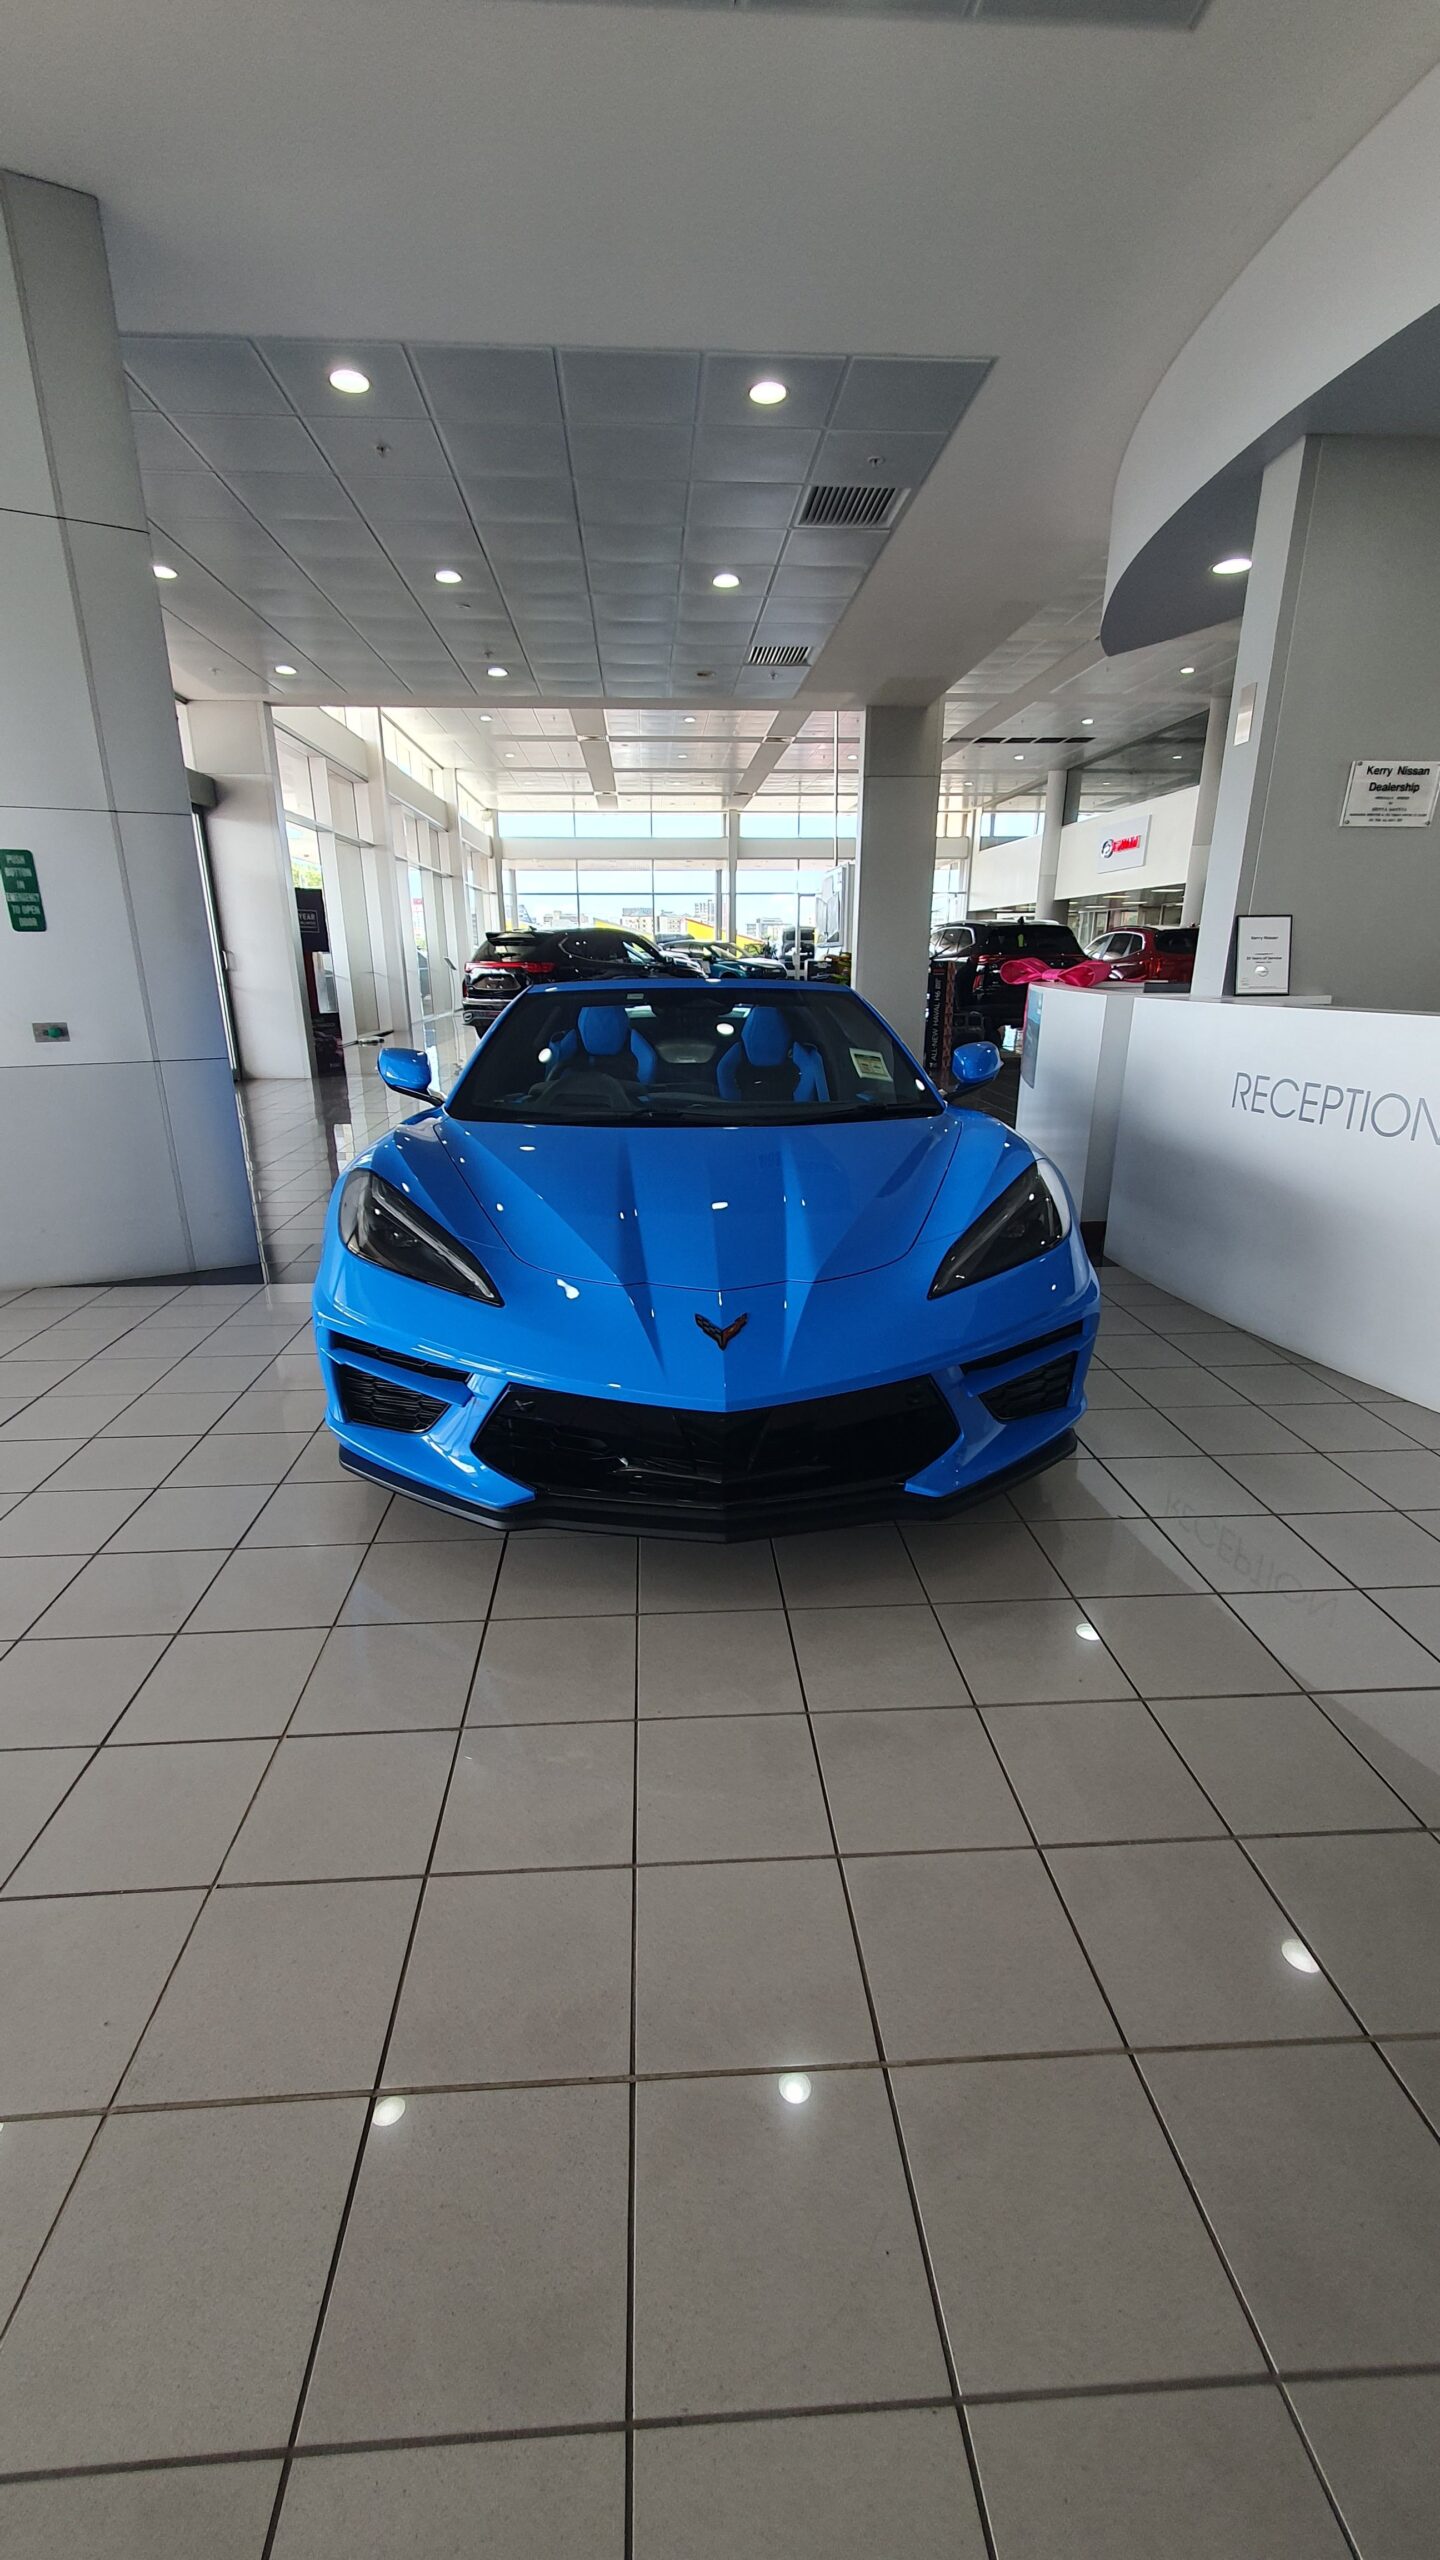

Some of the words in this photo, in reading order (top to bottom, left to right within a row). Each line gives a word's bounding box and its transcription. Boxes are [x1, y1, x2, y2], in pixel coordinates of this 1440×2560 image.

[1366, 765, 1393, 777] Kerry
[1397, 765, 1430, 776] Nissan
[1368, 782, 1420, 793] Dealership
[11, 904, 21, 914] TO
[22, 904, 41, 915] OPEN
[932, 1002, 941, 1026] HAVAL
[930, 1029, 938, 1061] ALL-NEW
[1231, 1072, 1440, 1146] RECEPTION
